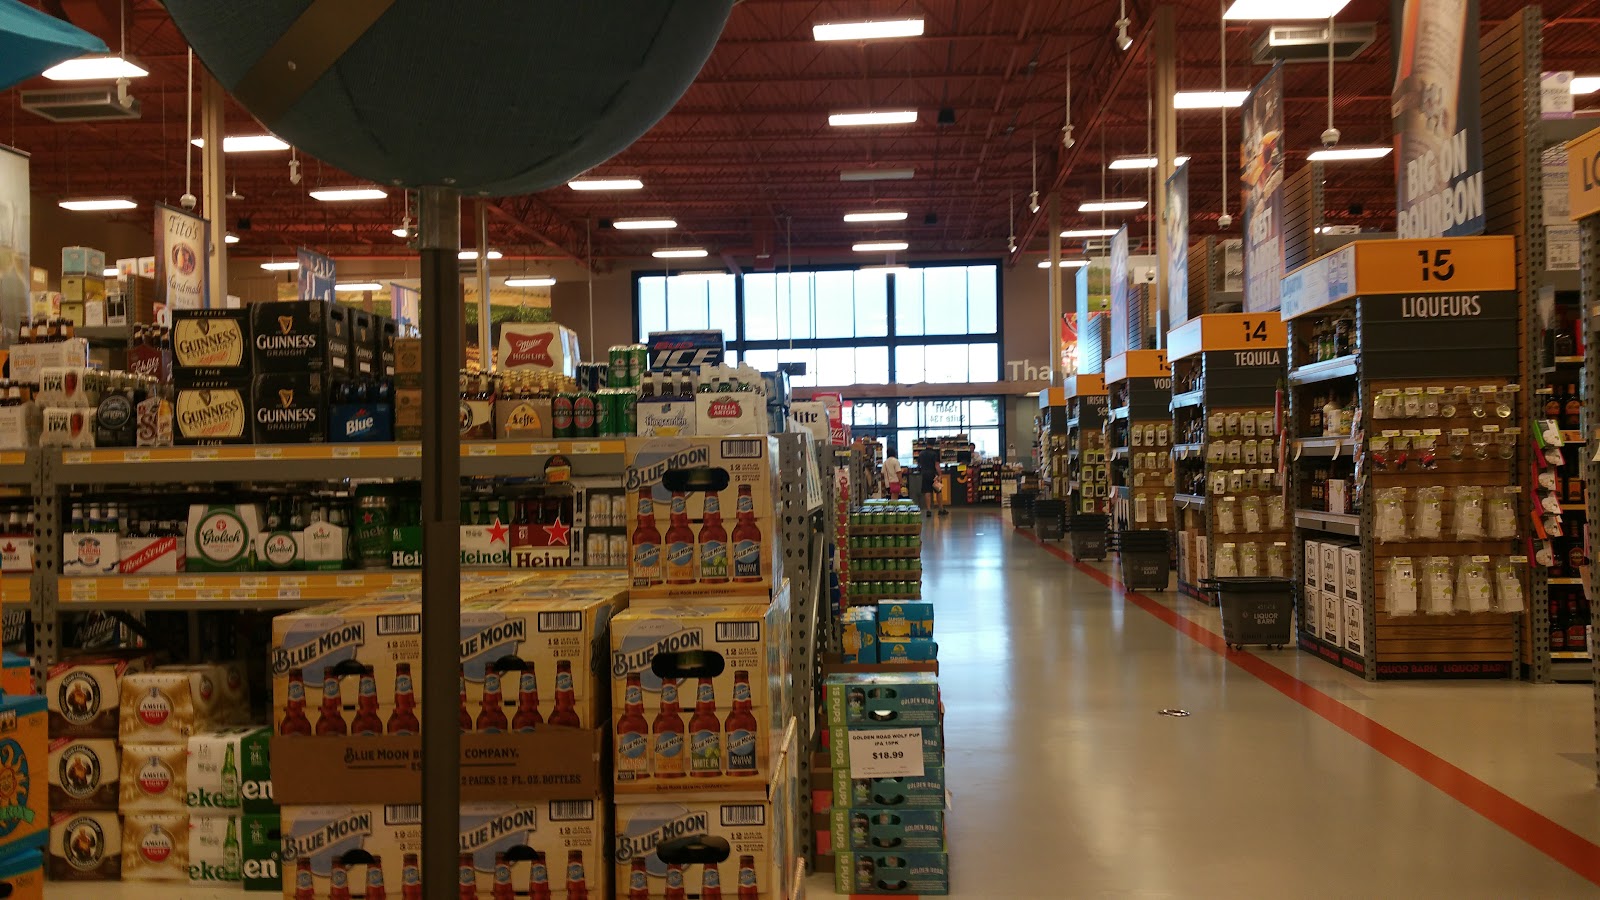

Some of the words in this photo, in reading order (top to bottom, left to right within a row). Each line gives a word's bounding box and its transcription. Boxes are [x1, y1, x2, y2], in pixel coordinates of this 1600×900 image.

[1407, 149, 1438, 202] BIG
[1439, 128, 1467, 183] ON
[1398, 171, 1483, 239] BOURBON
[169, 214, 199, 240] Tito's
[1418, 249, 1455, 281] 15
[1402, 294, 1481, 319] LIQUEURS
[1243, 320, 1268, 342] 14
[179, 328, 237, 354] GUINNESS
[255, 333, 317, 349] GUINNESS
[653, 341, 694, 350] BUD
[266, 349, 307, 357] DRAUGHT
[652, 348, 722, 368] ICE
[1234, 350, 1280, 367] TEQUILA
[43, 381, 63, 392] IPA
[181, 400, 239, 426] GUINNESS
[257, 407, 317, 424] GUINNESS
[713, 403, 737, 411] STELLA
[713, 409, 738, 417] ARTOIS
[48, 421, 68, 432] IPA
[266, 422, 308, 431] DRAUGHT
[346, 415, 374, 436] Blue
[626, 462, 665, 491] BLUE
[667, 447, 707, 470] MOON
[202, 528, 242, 546] Grolsch
[391, 550, 423, 567] Hei
[1253, 612, 1279, 620] LIQUOR
[481, 621, 523, 649] MOON
[272, 643, 317, 675] BLUE
[318, 625, 361, 653] MOON
[613, 651, 654, 677] BLUE
[657, 631, 700, 654] MOON
[1411, 665, 1438, 673] BARN
[1443, 664, 1480, 673] LIQUOR
[833, 687, 840, 696] 15
[833, 696, 841, 723] PUPS
[836, 728, 843, 738] 15
[344, 747, 374, 764] BLUE
[377, 749, 410, 761] MOON
[836, 738, 844, 765] PUPS
[872, 751, 904, 760] $18.99
[543, 774, 582, 784] BOTTLES
[490, 809, 534, 839] MOON
[281, 835, 324, 862] BLUE
[326, 814, 370, 843] MOON
[615, 832, 660, 862] BLUE
[662, 814, 705, 842] MOON
